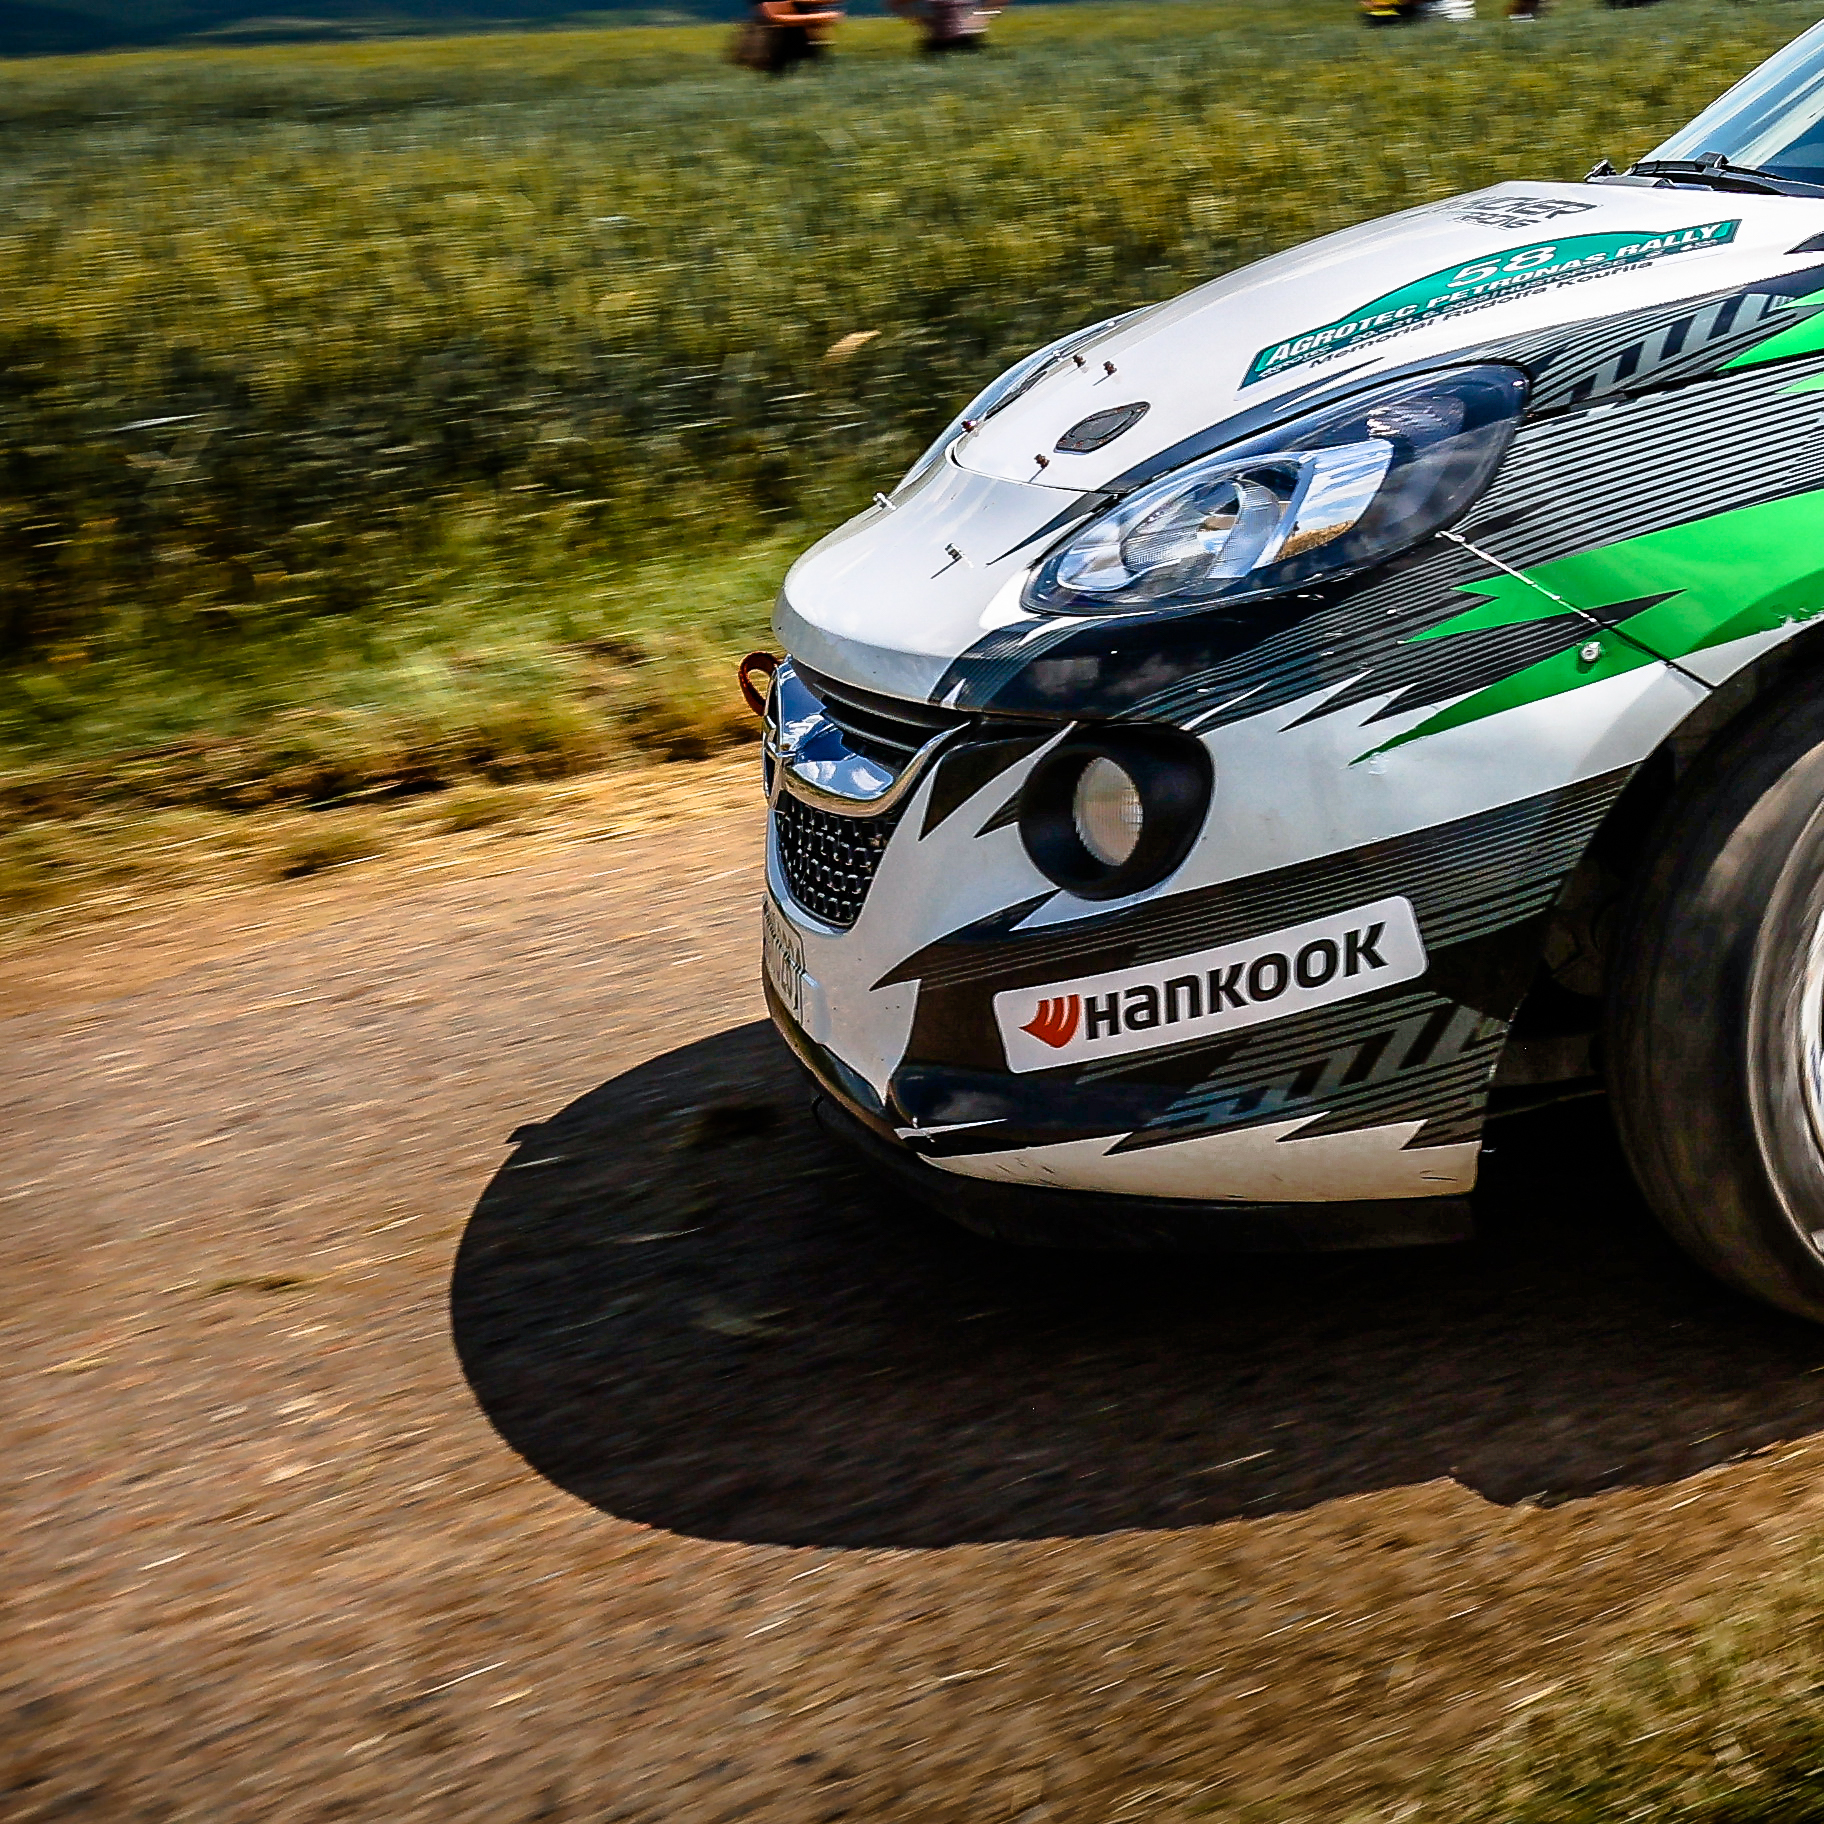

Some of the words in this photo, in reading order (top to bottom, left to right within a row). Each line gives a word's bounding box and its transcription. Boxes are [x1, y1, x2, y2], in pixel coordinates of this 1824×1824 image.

[1446, 245, 1558, 289] 58
[1265, 304, 1419, 367] AGROTEC
[1427, 252, 1607, 309] PETRONAS
[1616, 223, 1722, 258] RALLY
[1442, 286, 1547, 321] Rudolfa
